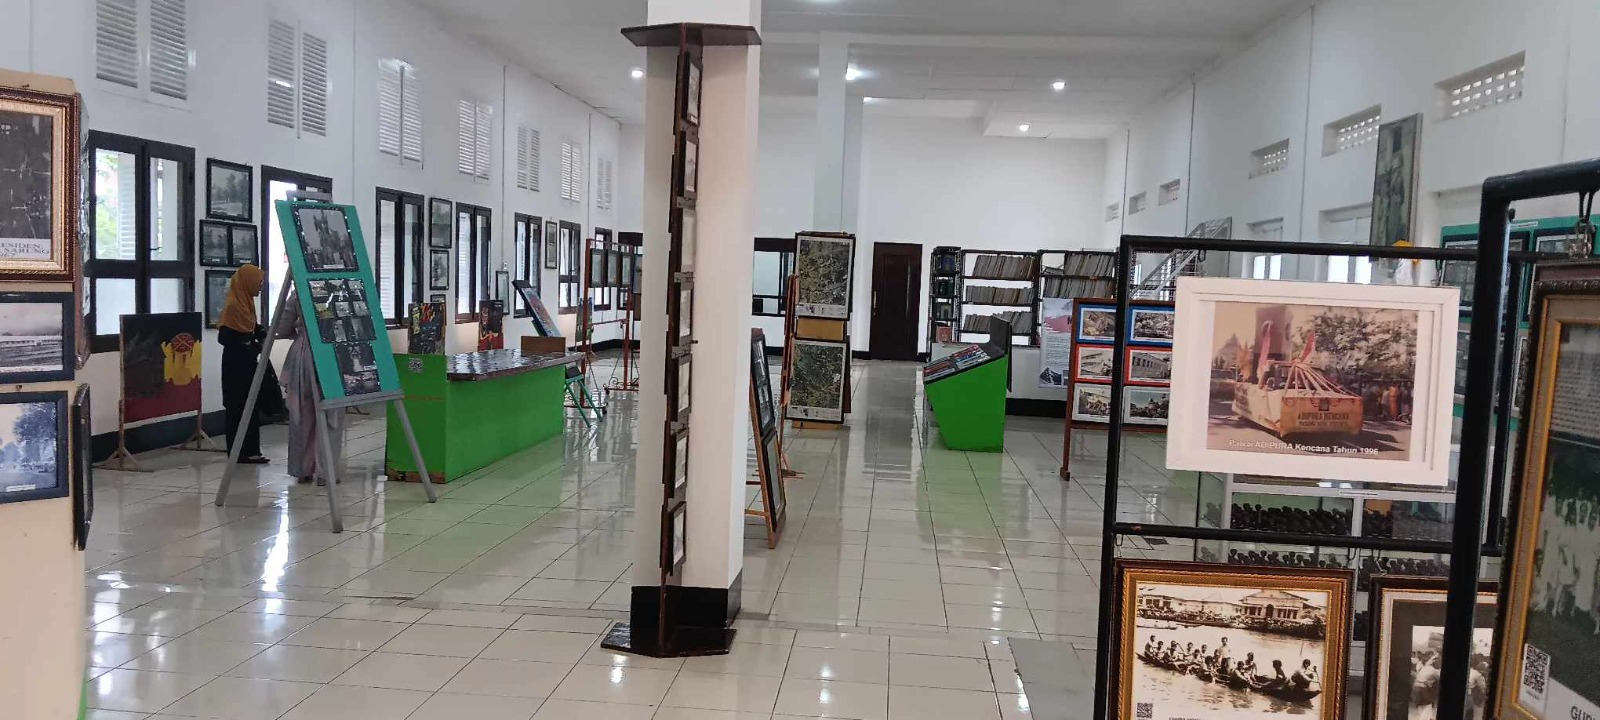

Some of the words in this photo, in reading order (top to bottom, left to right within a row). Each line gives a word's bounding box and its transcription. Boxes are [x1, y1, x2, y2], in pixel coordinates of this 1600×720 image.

[1255, 442, 1293, 450] ADIPURA
[1295, 443, 1330, 453] Kencana
[1333, 445, 1358, 454] Tahun
[1360, 447, 1379, 455] 1996
